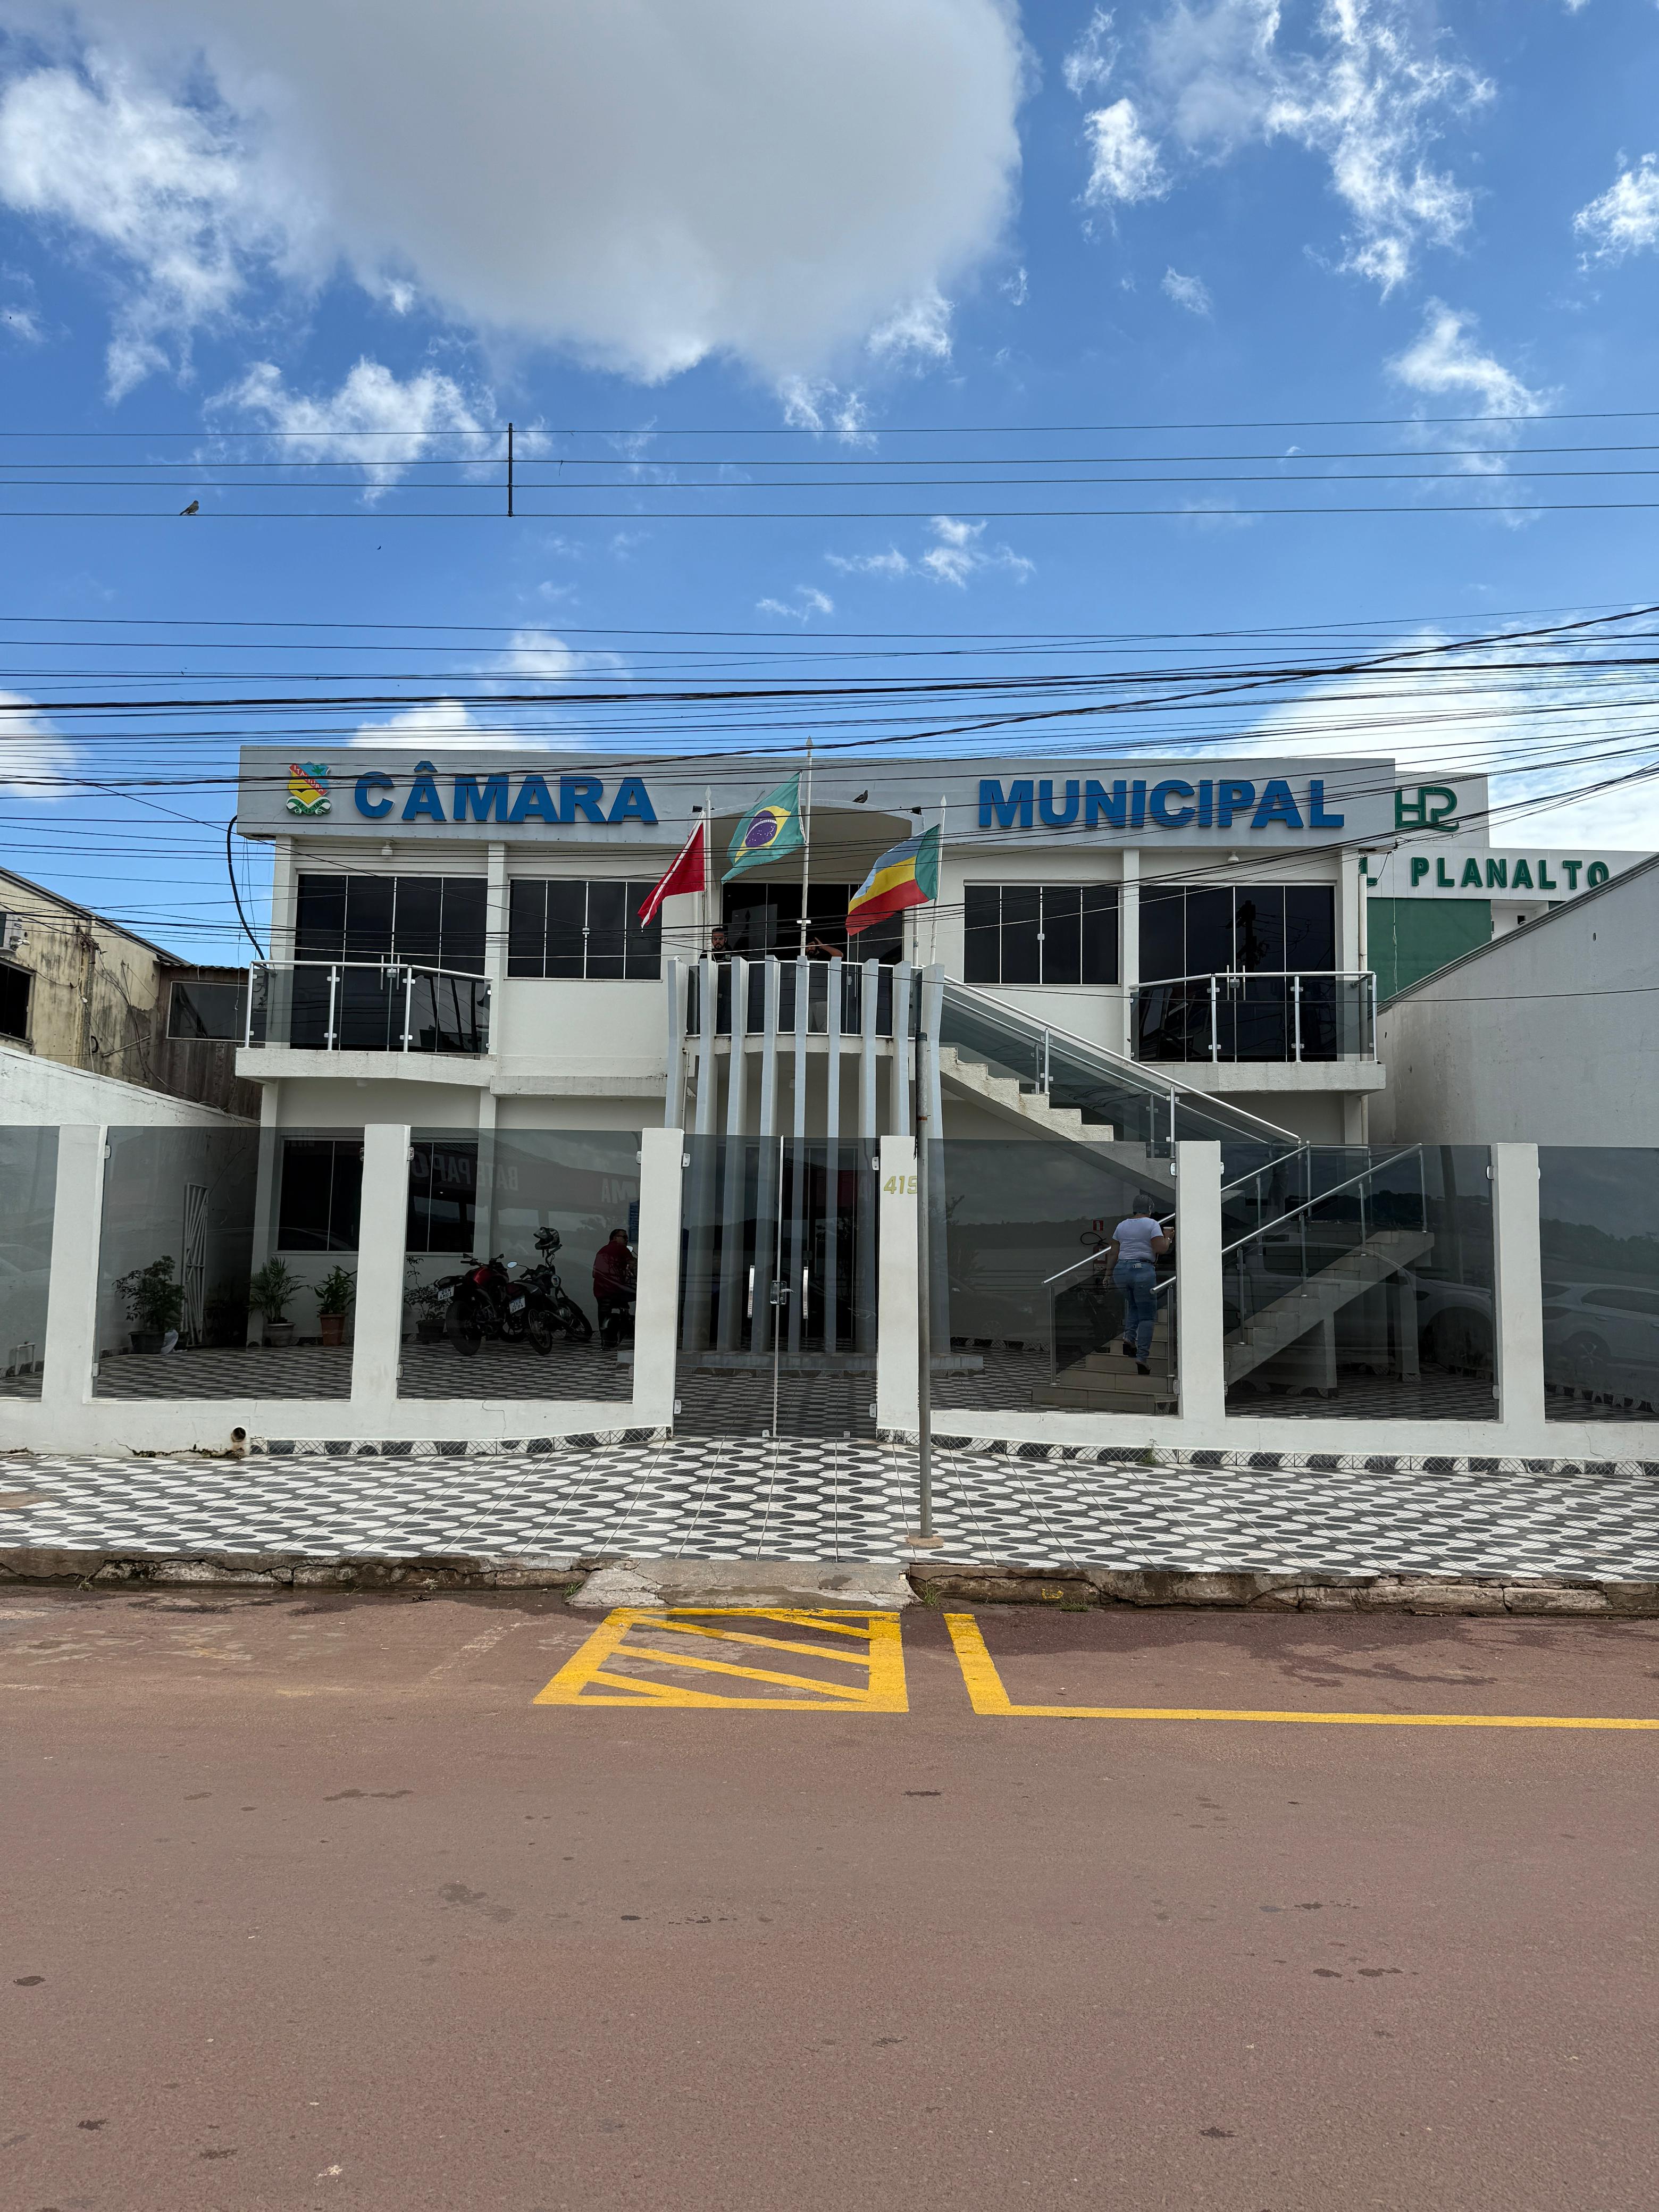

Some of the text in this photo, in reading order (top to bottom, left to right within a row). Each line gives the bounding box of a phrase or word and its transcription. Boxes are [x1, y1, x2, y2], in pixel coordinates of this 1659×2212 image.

[354, 760, 1344, 828] CÂMARA MUNICIPAL
[1411, 857, 1610, 890] PLANALTO
